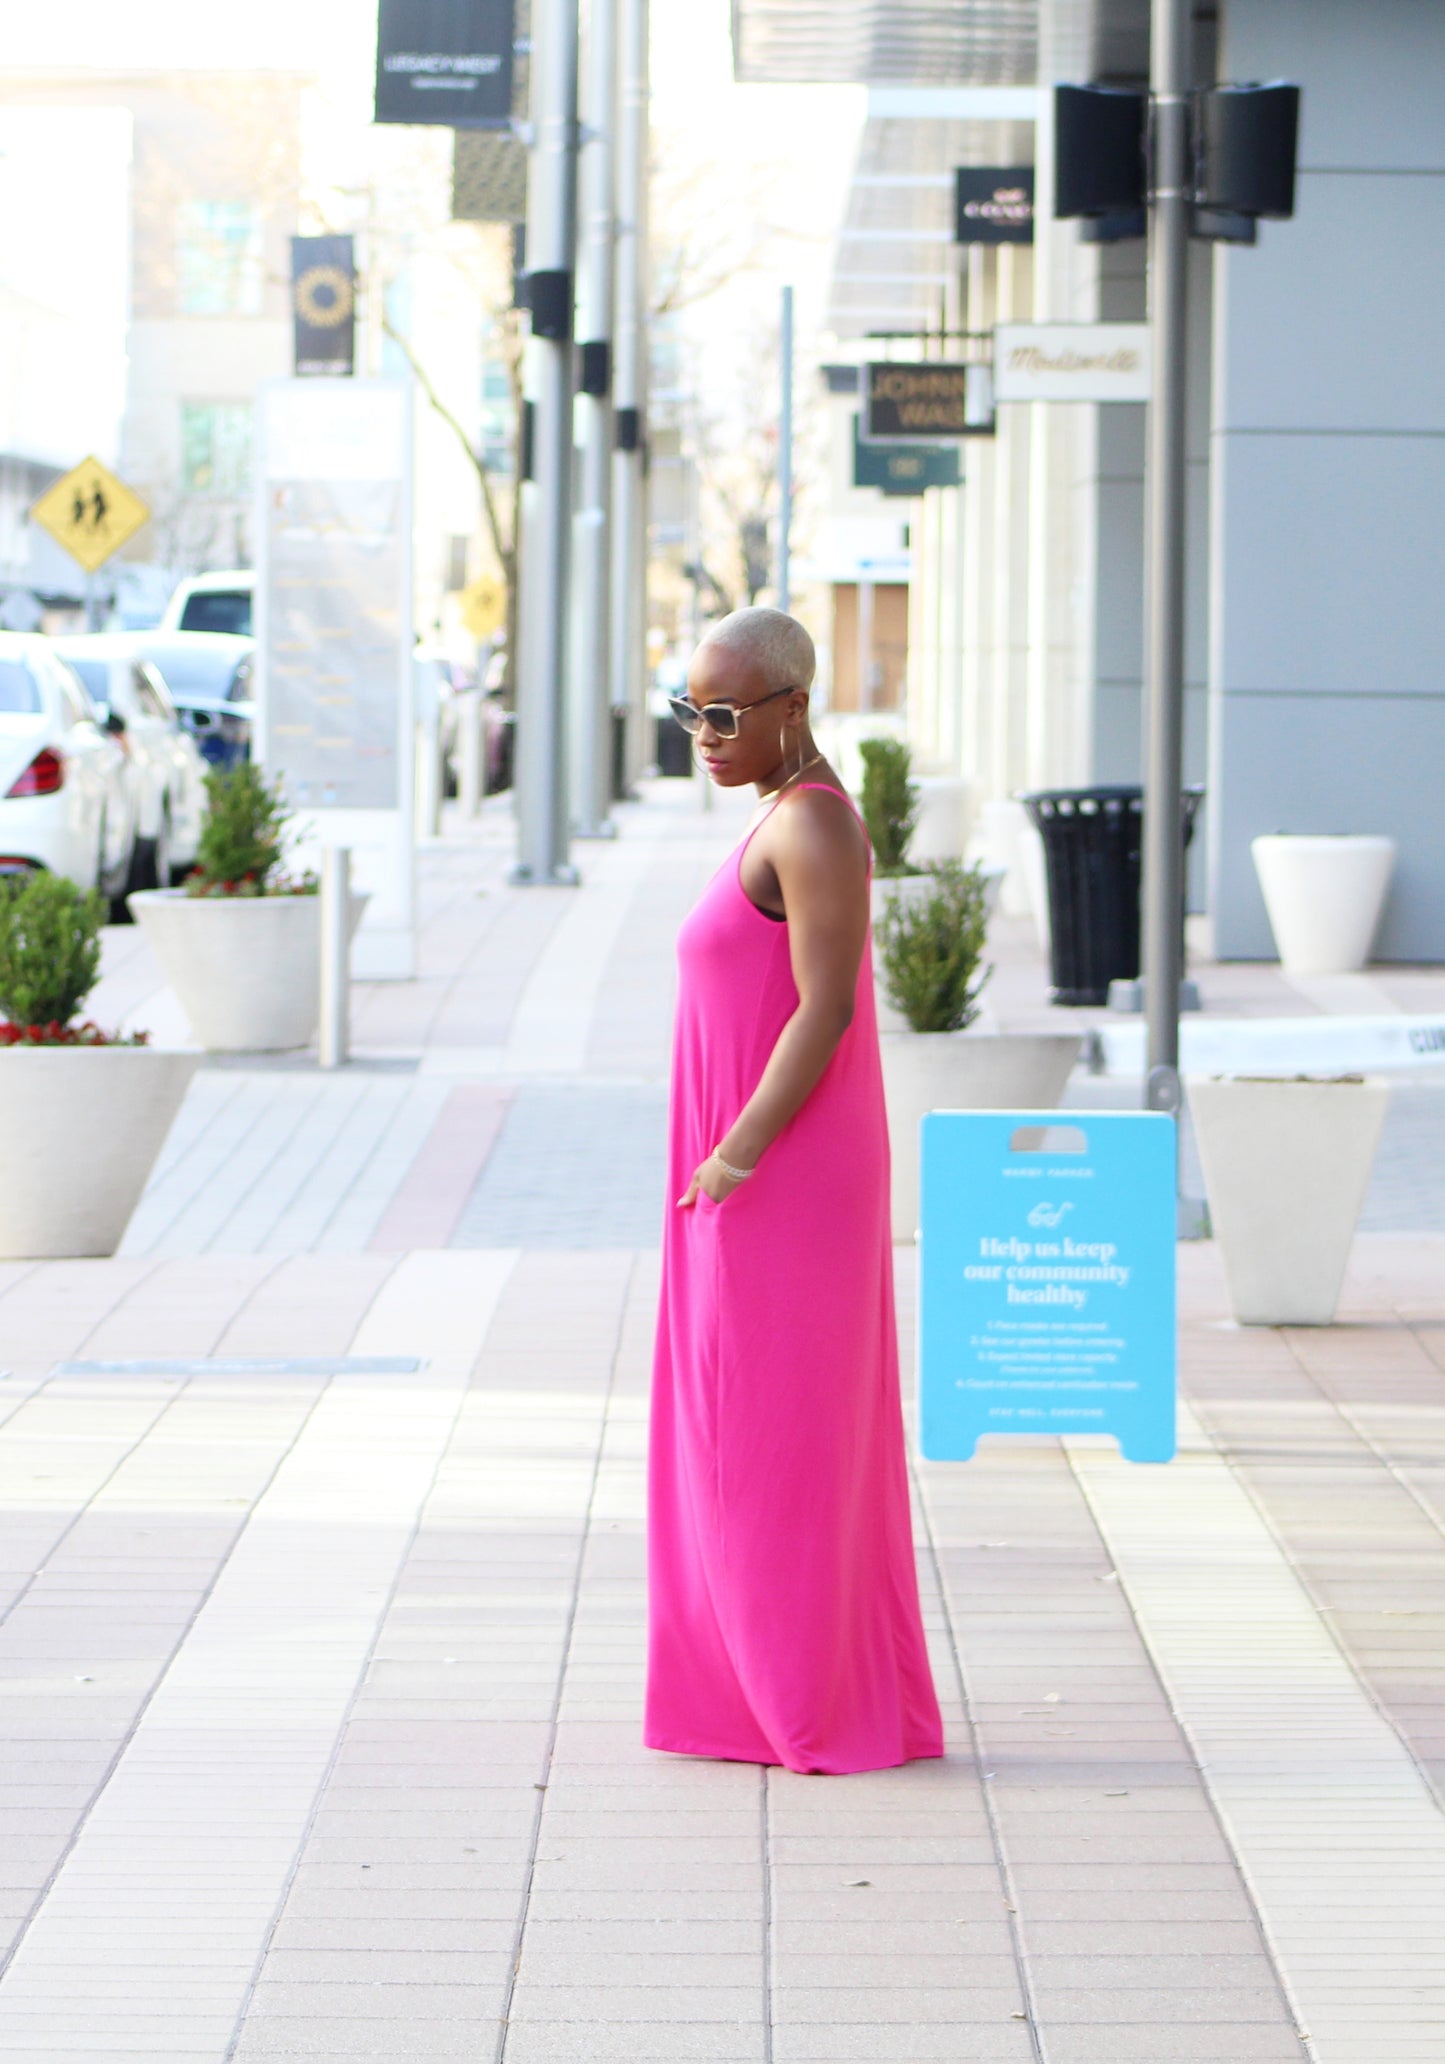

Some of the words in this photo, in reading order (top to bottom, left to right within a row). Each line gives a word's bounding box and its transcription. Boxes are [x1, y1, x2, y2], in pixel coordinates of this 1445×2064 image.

[980, 1237, 1031, 1263] Help
[1035, 1243, 1060, 1258] us
[1063, 1237, 1117, 1264] keep
[963, 1265, 1003, 1281] our
[1006, 1265, 1131, 1288] community
[1007, 1283, 1088, 1309] healthy
